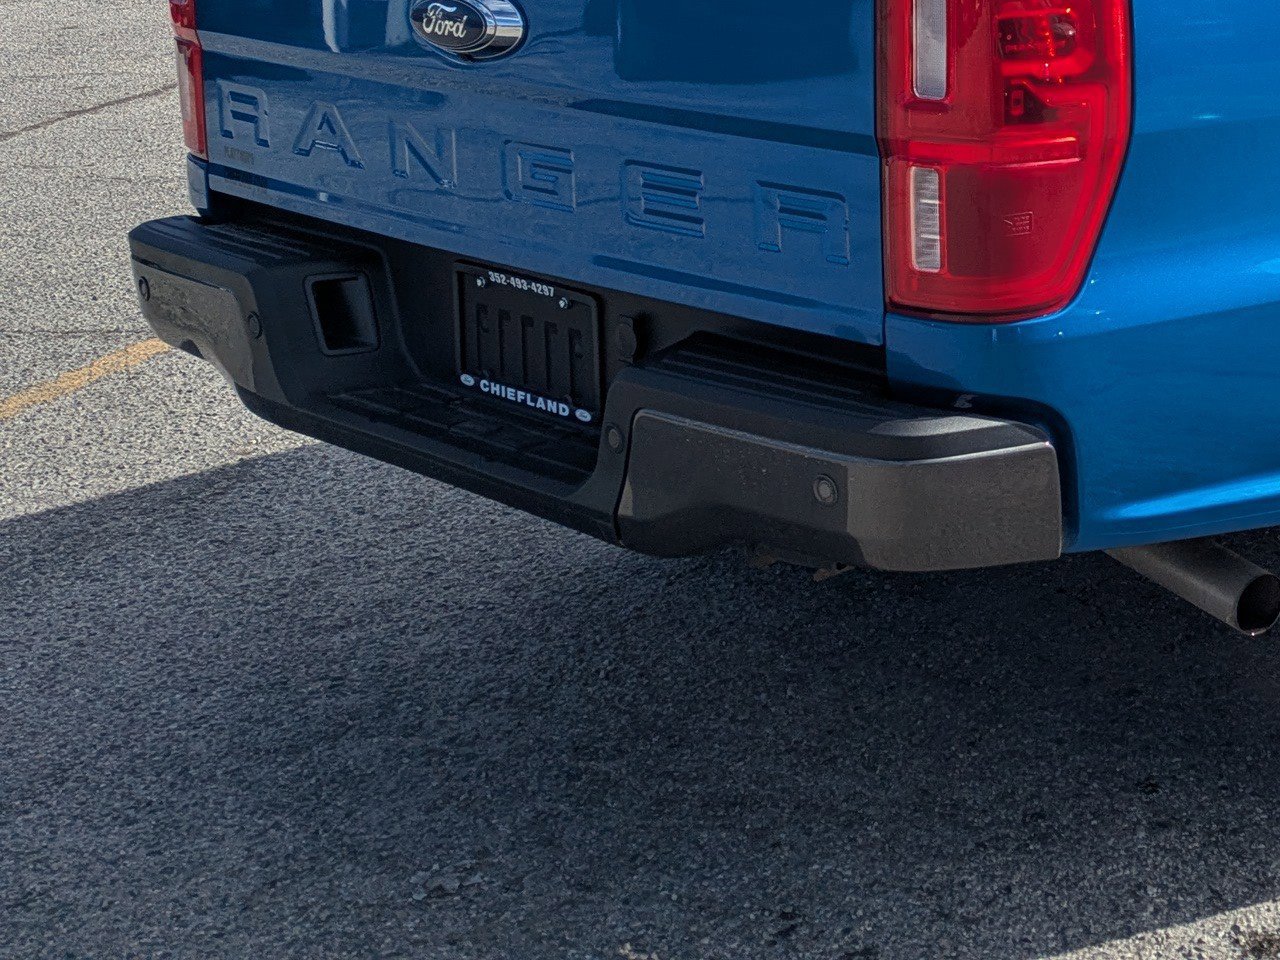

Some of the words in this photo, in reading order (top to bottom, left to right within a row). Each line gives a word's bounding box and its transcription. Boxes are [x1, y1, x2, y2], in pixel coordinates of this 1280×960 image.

[422, 2, 468, 39] Ford
[215, 77, 850, 267] RANGER
[488, 271, 555, 297] 352-493-4297
[479, 379, 570, 417] CHIEFLAND
